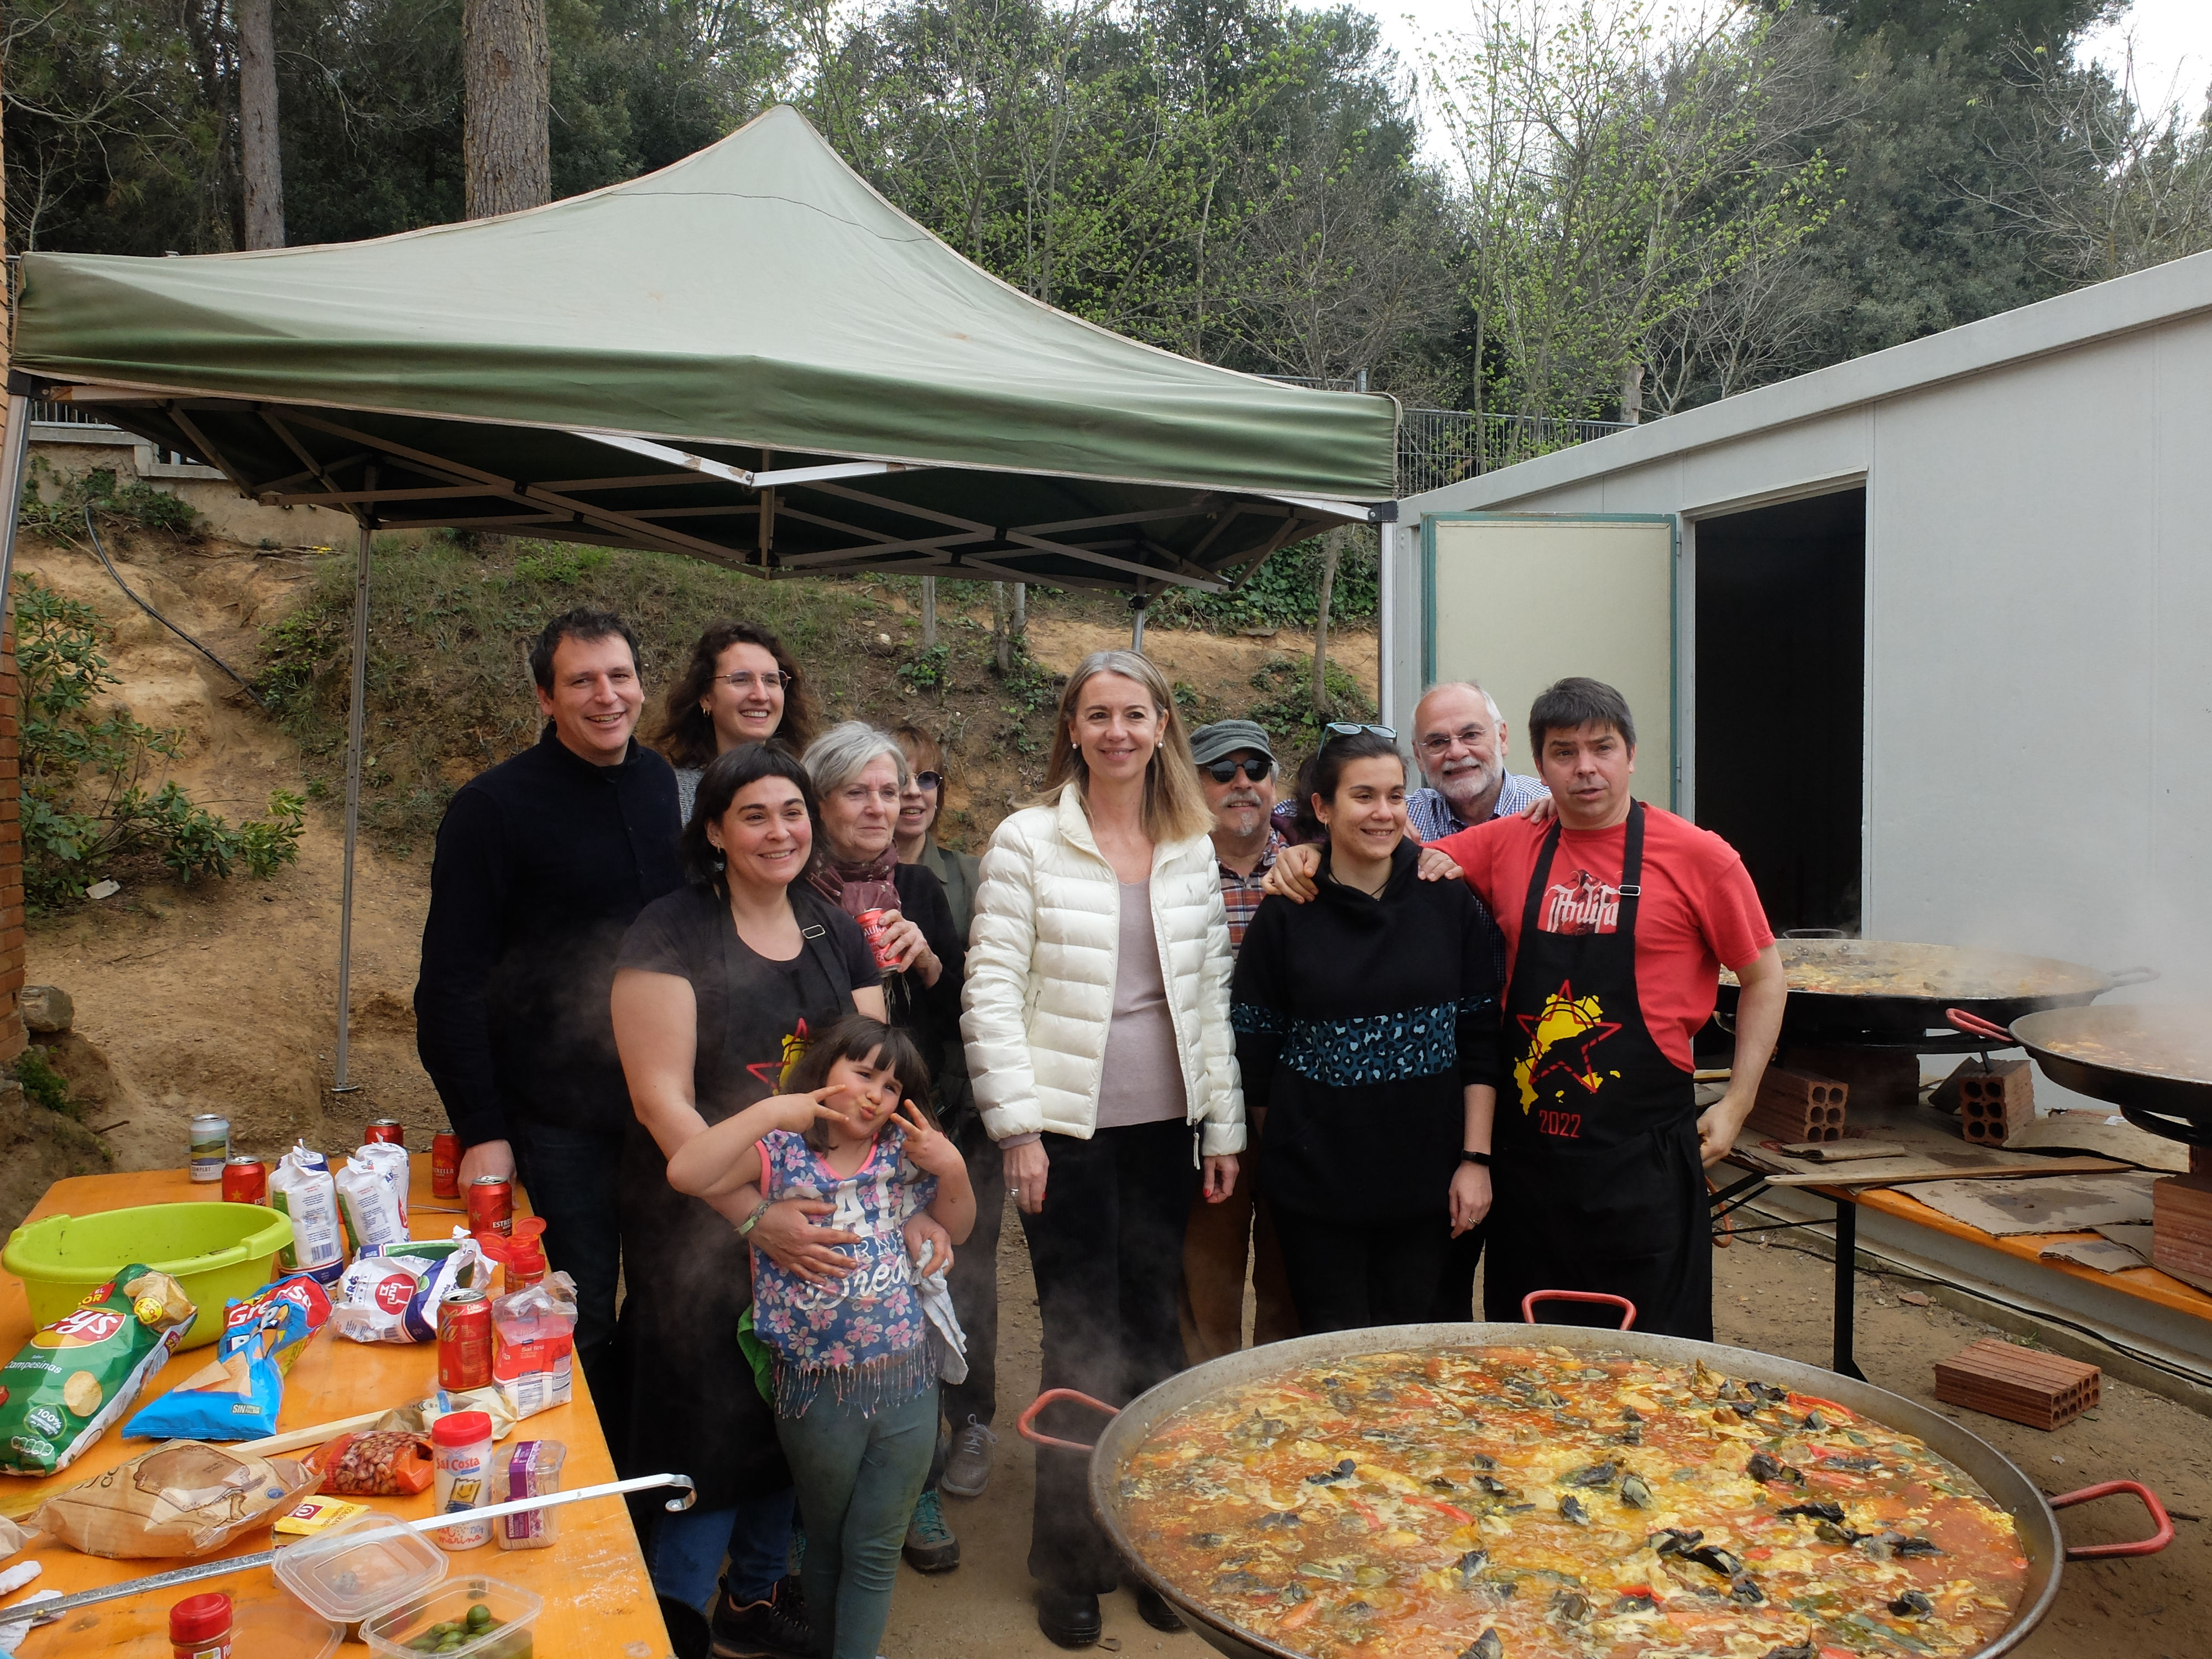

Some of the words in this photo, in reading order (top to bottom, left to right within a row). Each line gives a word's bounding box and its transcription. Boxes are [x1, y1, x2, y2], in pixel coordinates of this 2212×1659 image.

[1539, 1109, 1581, 1138] 2022
[4, 1360, 62, 1374] Campesinas
[232, 1404, 246, 1413] SIN
[37, 1408, 62, 1429] 100%
[436, 1457, 449, 1470] Sal
[451, 1457, 481, 1471] Costa
[439, 1534, 482, 1545] marina
